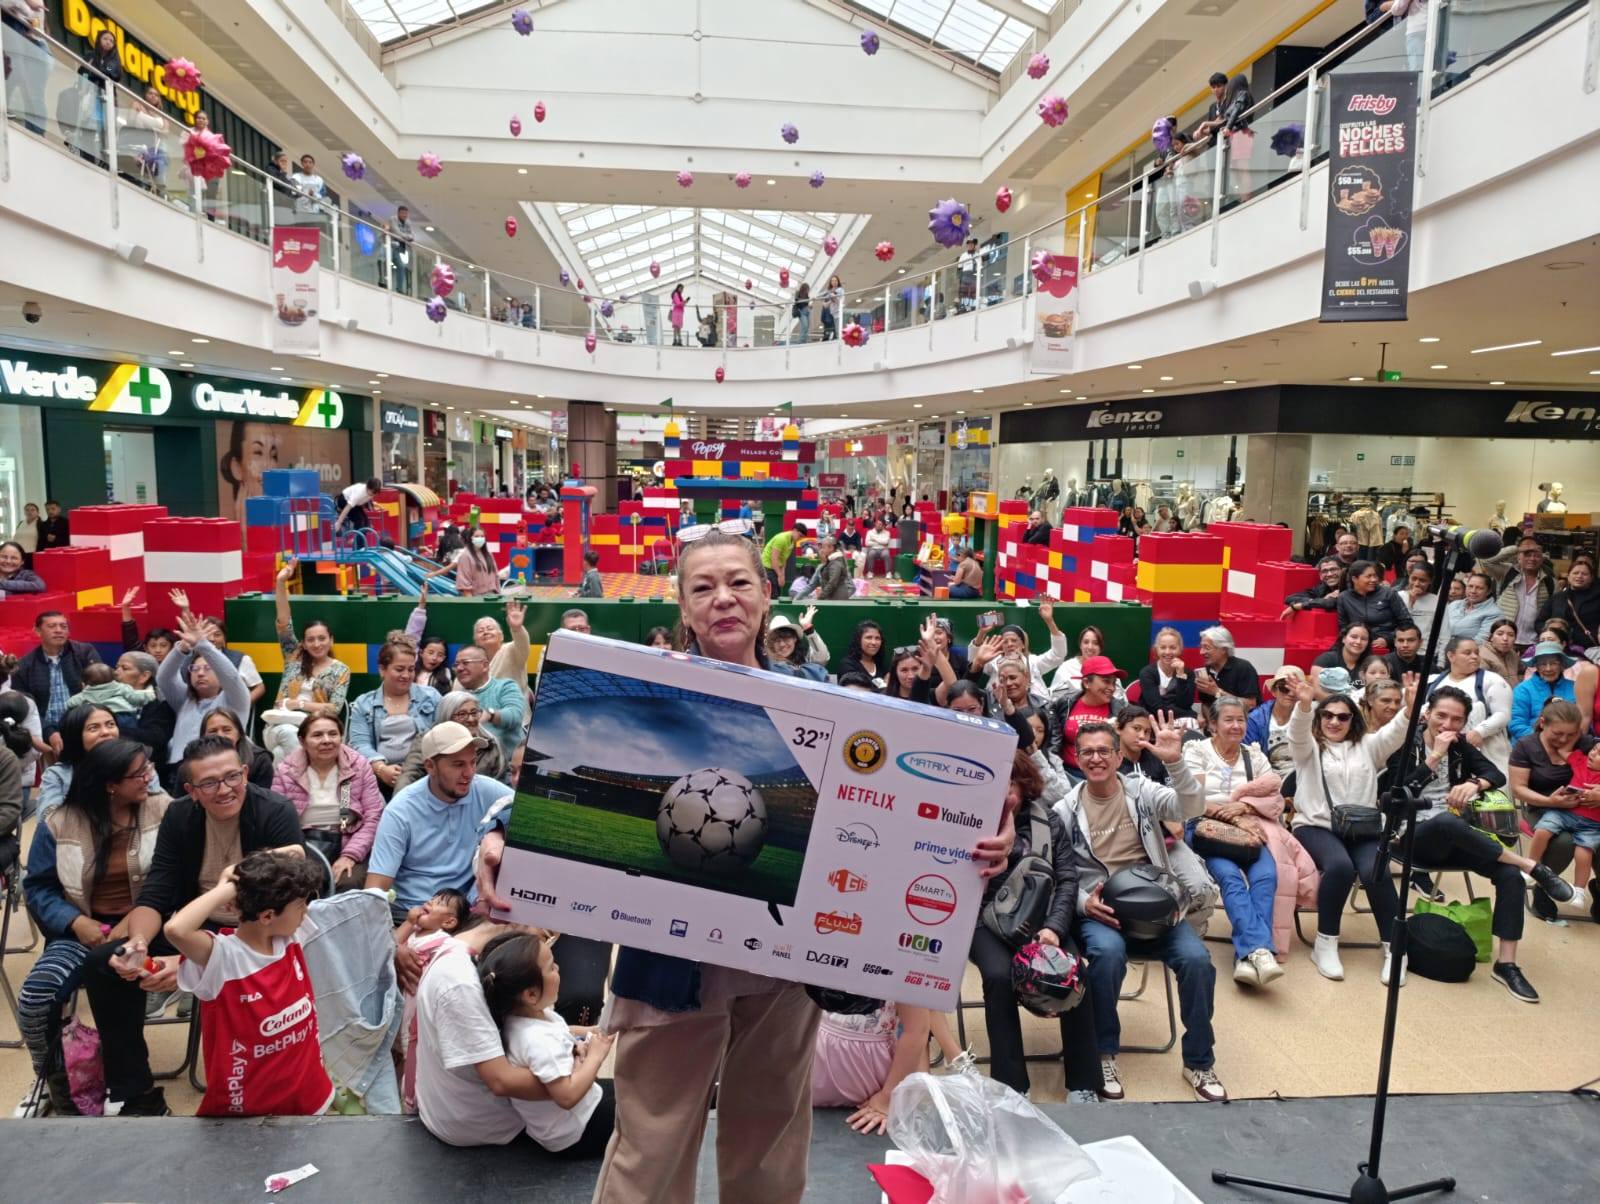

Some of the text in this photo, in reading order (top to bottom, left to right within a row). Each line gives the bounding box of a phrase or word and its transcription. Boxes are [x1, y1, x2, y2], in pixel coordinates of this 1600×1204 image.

[1347, 95, 1397, 116] Frisby
[1339, 124, 1403, 143] NOCHES
[1339, 137, 1405, 157] FELICES
[0, 359, 97, 401] Verde
[1086, 409, 1163, 429] Kenzo
[1504, 400, 1600, 424] Ken
[1125, 423, 1161, 432] jeans
[692, 441, 727, 460] Popsy
[909, 756, 986, 781] MATRIX PLUS
[837, 784, 896, 811] NETFLIX
[941, 807, 983, 829] YouTube
[913, 840, 947, 856] prime
[510, 887, 558, 905] HDMI
[913, 883, 945, 897] SMART
[619, 912, 653, 926] Bluetooth
[816, 916, 859, 932] FLUJO
[863, 963, 882, 975] USB
[933, 981, 951, 991] 1GB
[240, 992, 263, 1003] FILA
[253, 1026, 309, 1059] BetPlay
[228, 1057, 248, 1113] BetPlay
